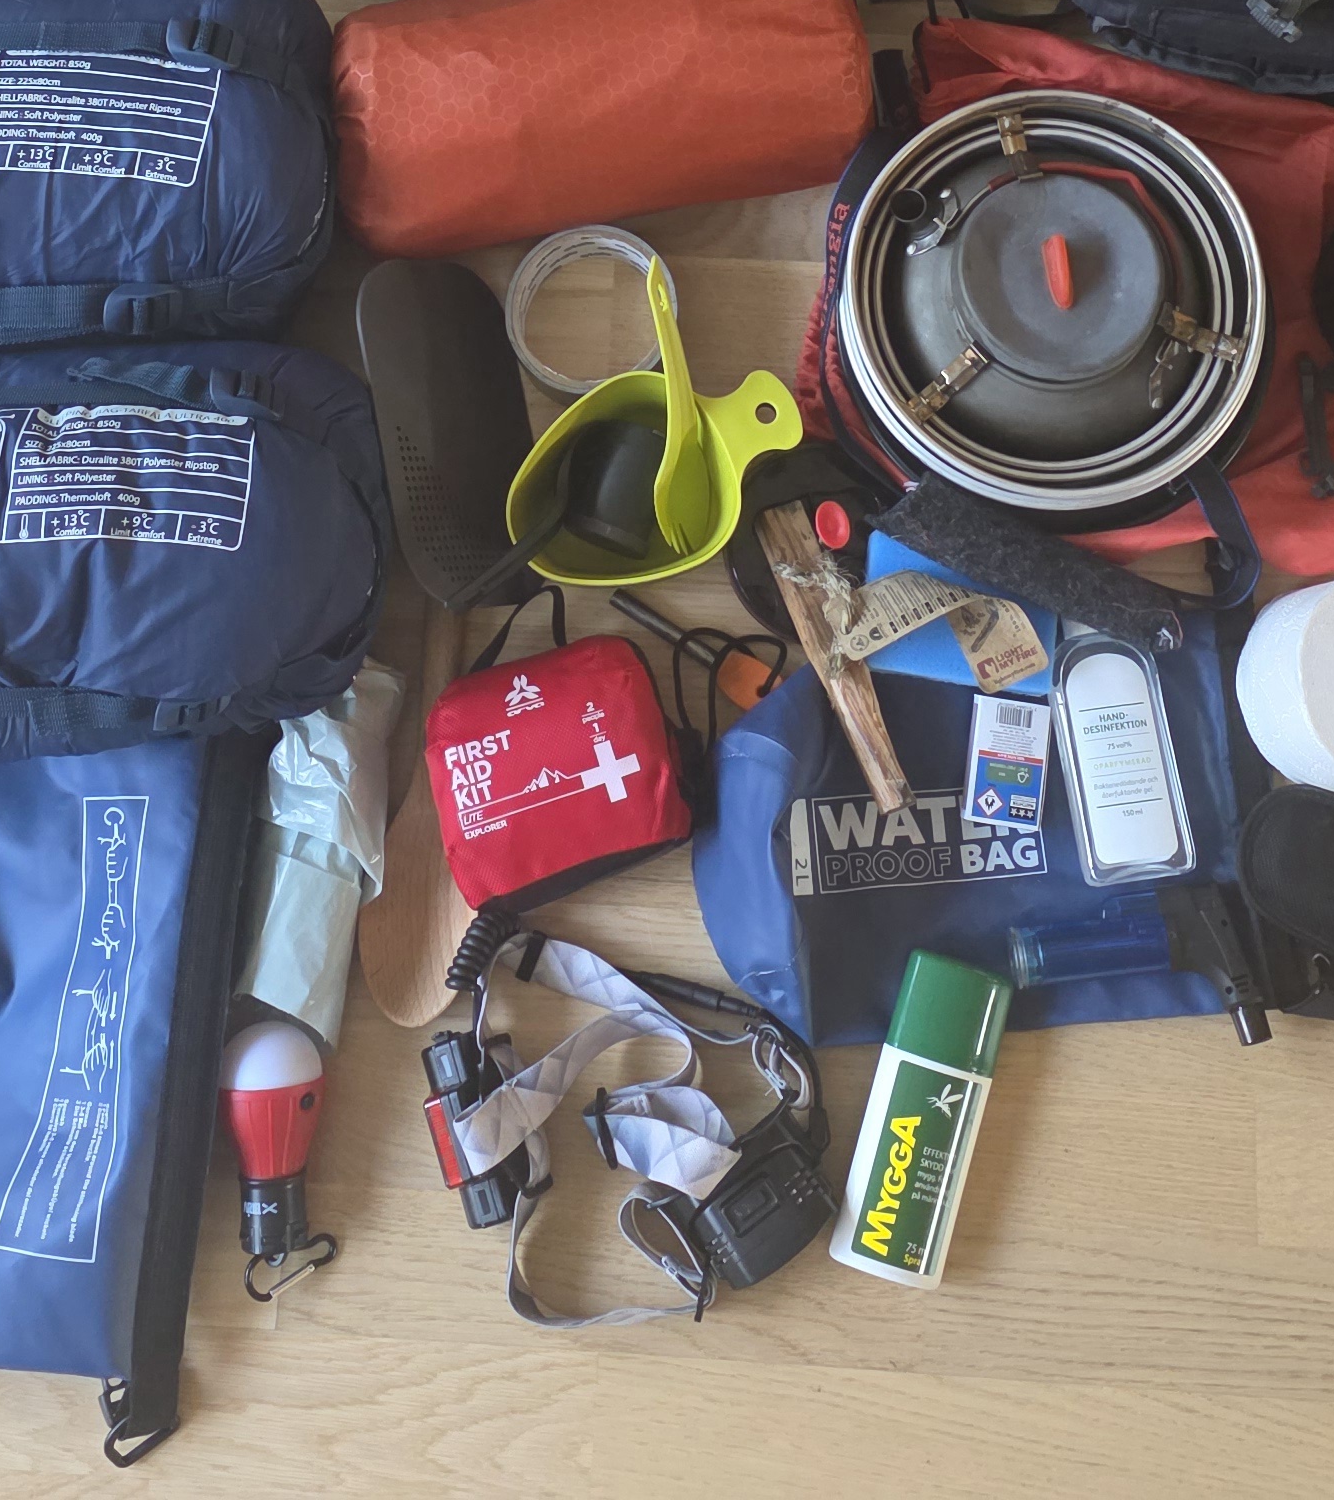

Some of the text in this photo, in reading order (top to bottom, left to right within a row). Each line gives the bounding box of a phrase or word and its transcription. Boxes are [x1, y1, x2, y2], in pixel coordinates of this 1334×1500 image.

[68, 60, 91, 69] 850g
[17, 78, 60, 86] 225x80cm
[51, 95, 85, 105] Duralite
[87, 97, 108, 107] 380T
[109, 99, 148, 111] Polyester
[149, 103, 182, 115] Ripstop
[24, 111, 41, 119] Soft
[43, 112, 82, 122] Polyester
[28, 130, 76, 140] Thermoloft
[81, 133, 103, 143] 400g
[18, 160, 51, 169] Comfort
[72, 163, 125, 175] Limit Comfort
[145, 170, 178, 182] Extreme
[43, 409, 92, 426] SLPING
[31, 423, 58, 437] TOTAL
[96, 419, 121, 429] 850g
[81, 455, 118, 465] Duralite
[120, 456, 142, 466] 380T
[143, 457, 183, 468] Polyester
[184, 460, 220, 472] Ripstop
[54, 473, 72, 483] Soft
[74, 472, 116, 483] Polyester
[14, 491, 140, 506] PADDING: Thermoloft 400g
[53, 526, 87, 537] Comfort
[110, 528, 165, 540] Limit Comfort
[188, 533, 222, 546] Extreme
[995, 644, 1024, 663] LIGHT
[998, 646, 1038, 671] MY FIRE
[586, 702, 594, 712] 2
[581, 712, 605, 724] people
[592, 722, 600, 732] 1
[1083, 719, 1148, 735] DESINFEKTION
[593, 734, 606, 743] day
[444, 730, 511, 770] FIRST
[451, 760, 492, 790] AID
[454, 780, 492, 810] KIT
[464, 810, 483, 825] LITE
[1122, 808, 1134, 817] 150
[464, 819, 508, 840] EXPLORER
[818, 796, 1037, 850] WAT
[824, 837, 1039, 886] PROOF BAG
[860, 1115, 921, 1256] MYGGA
[905, 1241, 917, 1254] 75
[903, 1253, 923, 1267] Spra
